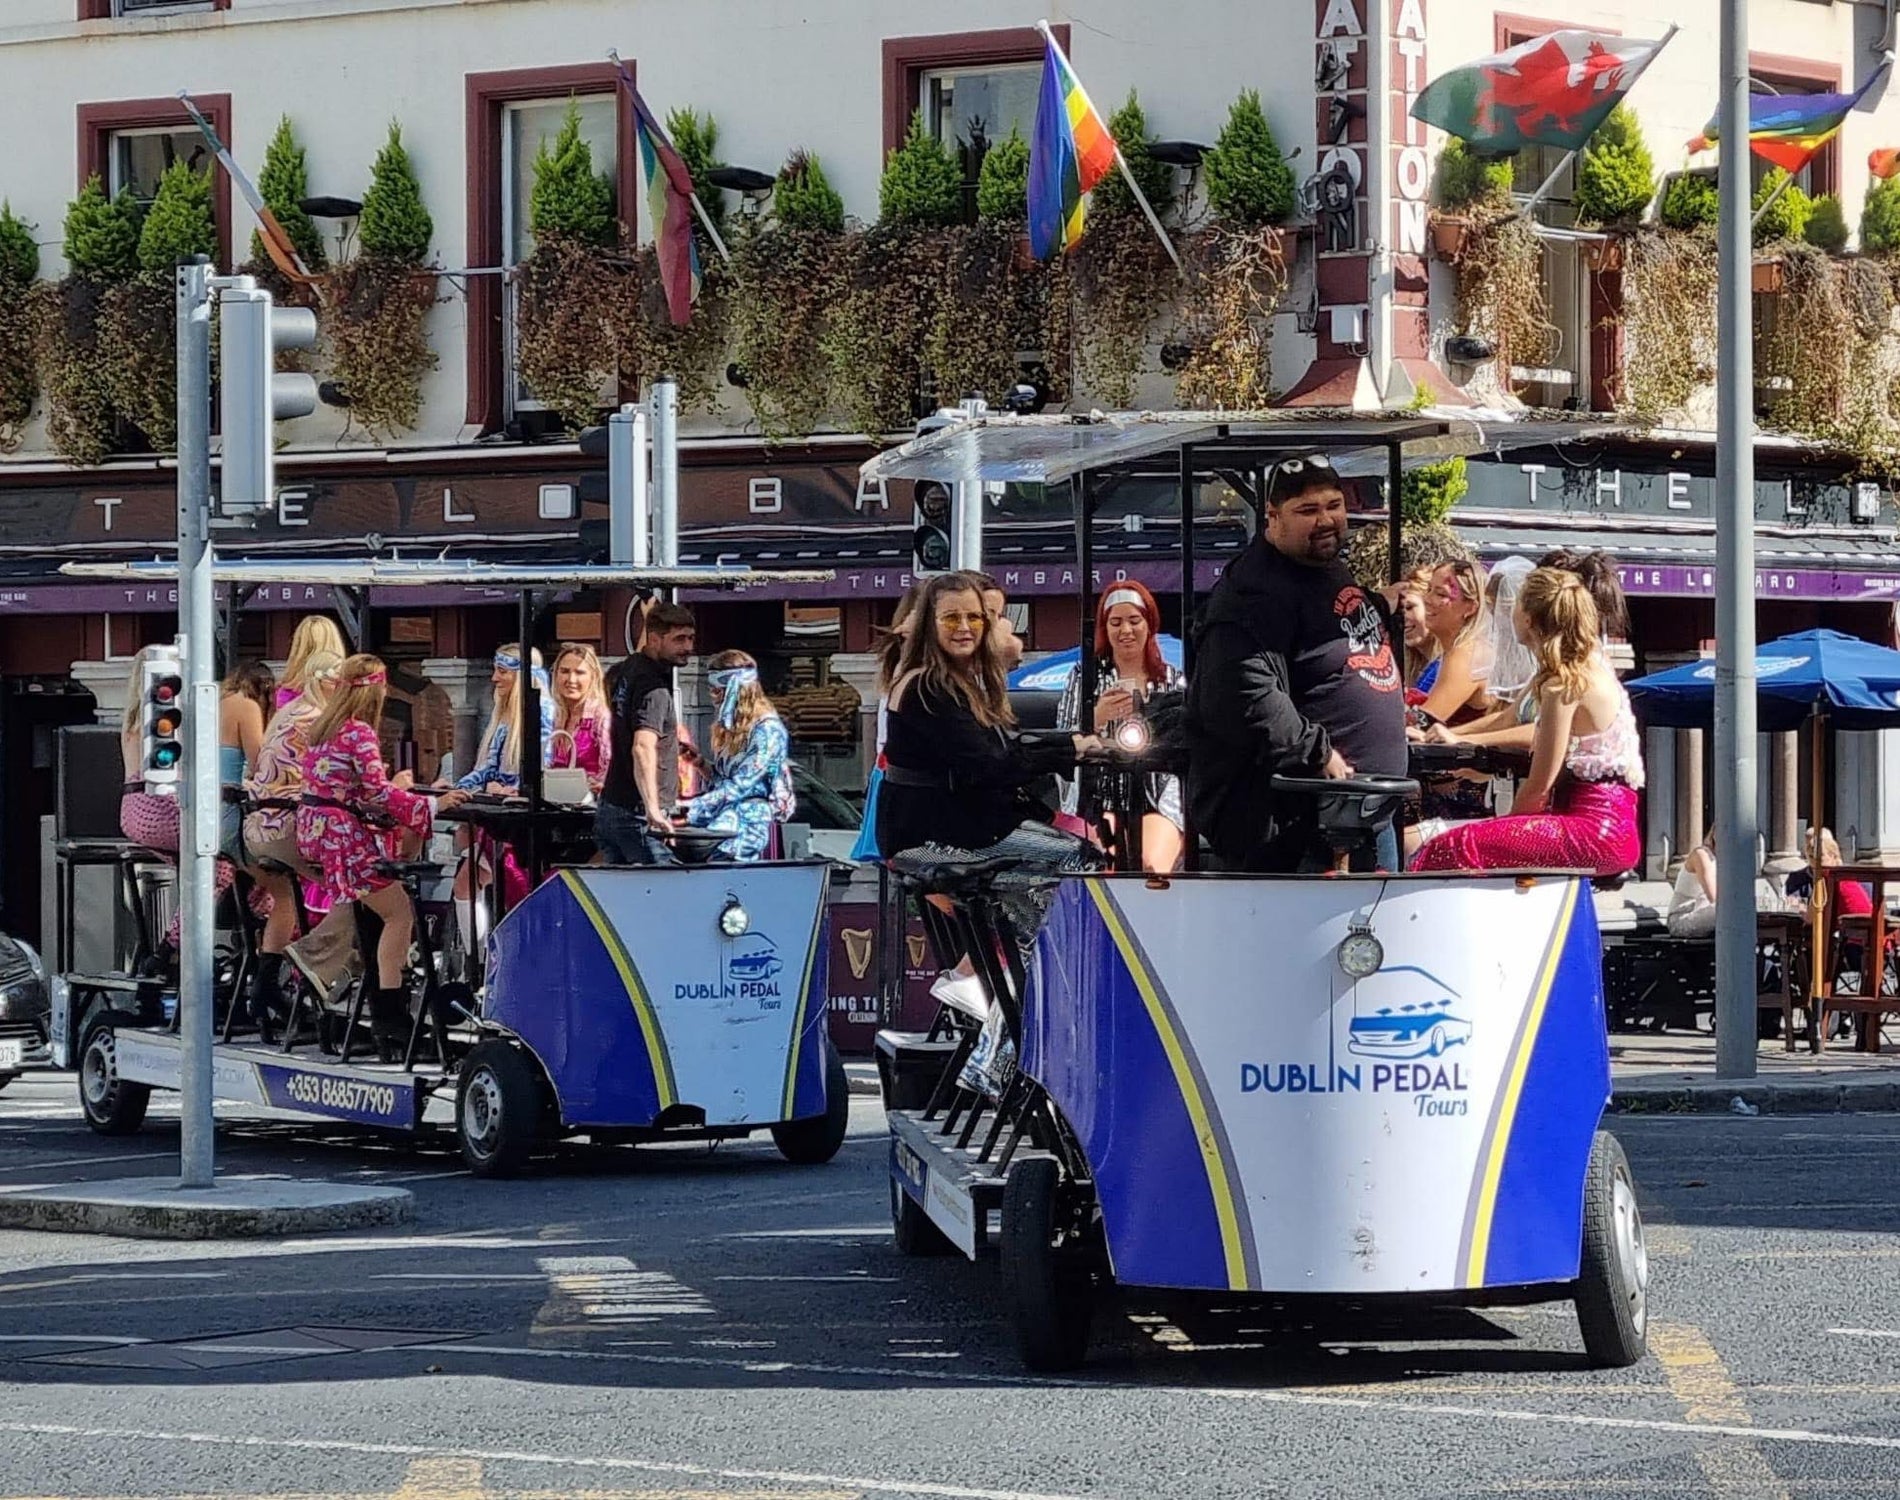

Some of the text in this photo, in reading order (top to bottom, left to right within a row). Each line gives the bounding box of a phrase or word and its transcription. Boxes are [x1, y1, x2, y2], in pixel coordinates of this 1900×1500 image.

[1521, 464, 1692, 511] THE
[94, 492, 309, 532] TE
[849, 574, 912, 588] THE
[1618, 570, 1796, 589] THE LOARD
[124, 588, 178, 603] THE
[674, 982, 781, 999] DUBLIN PEDAL
[1240, 1063, 1468, 1093] DUBLIN PEDAL
[286, 1074, 320, 1103] +353
[321, 1078, 395, 1115] 868577909
[1413, 1094, 1469, 1117] Tours
